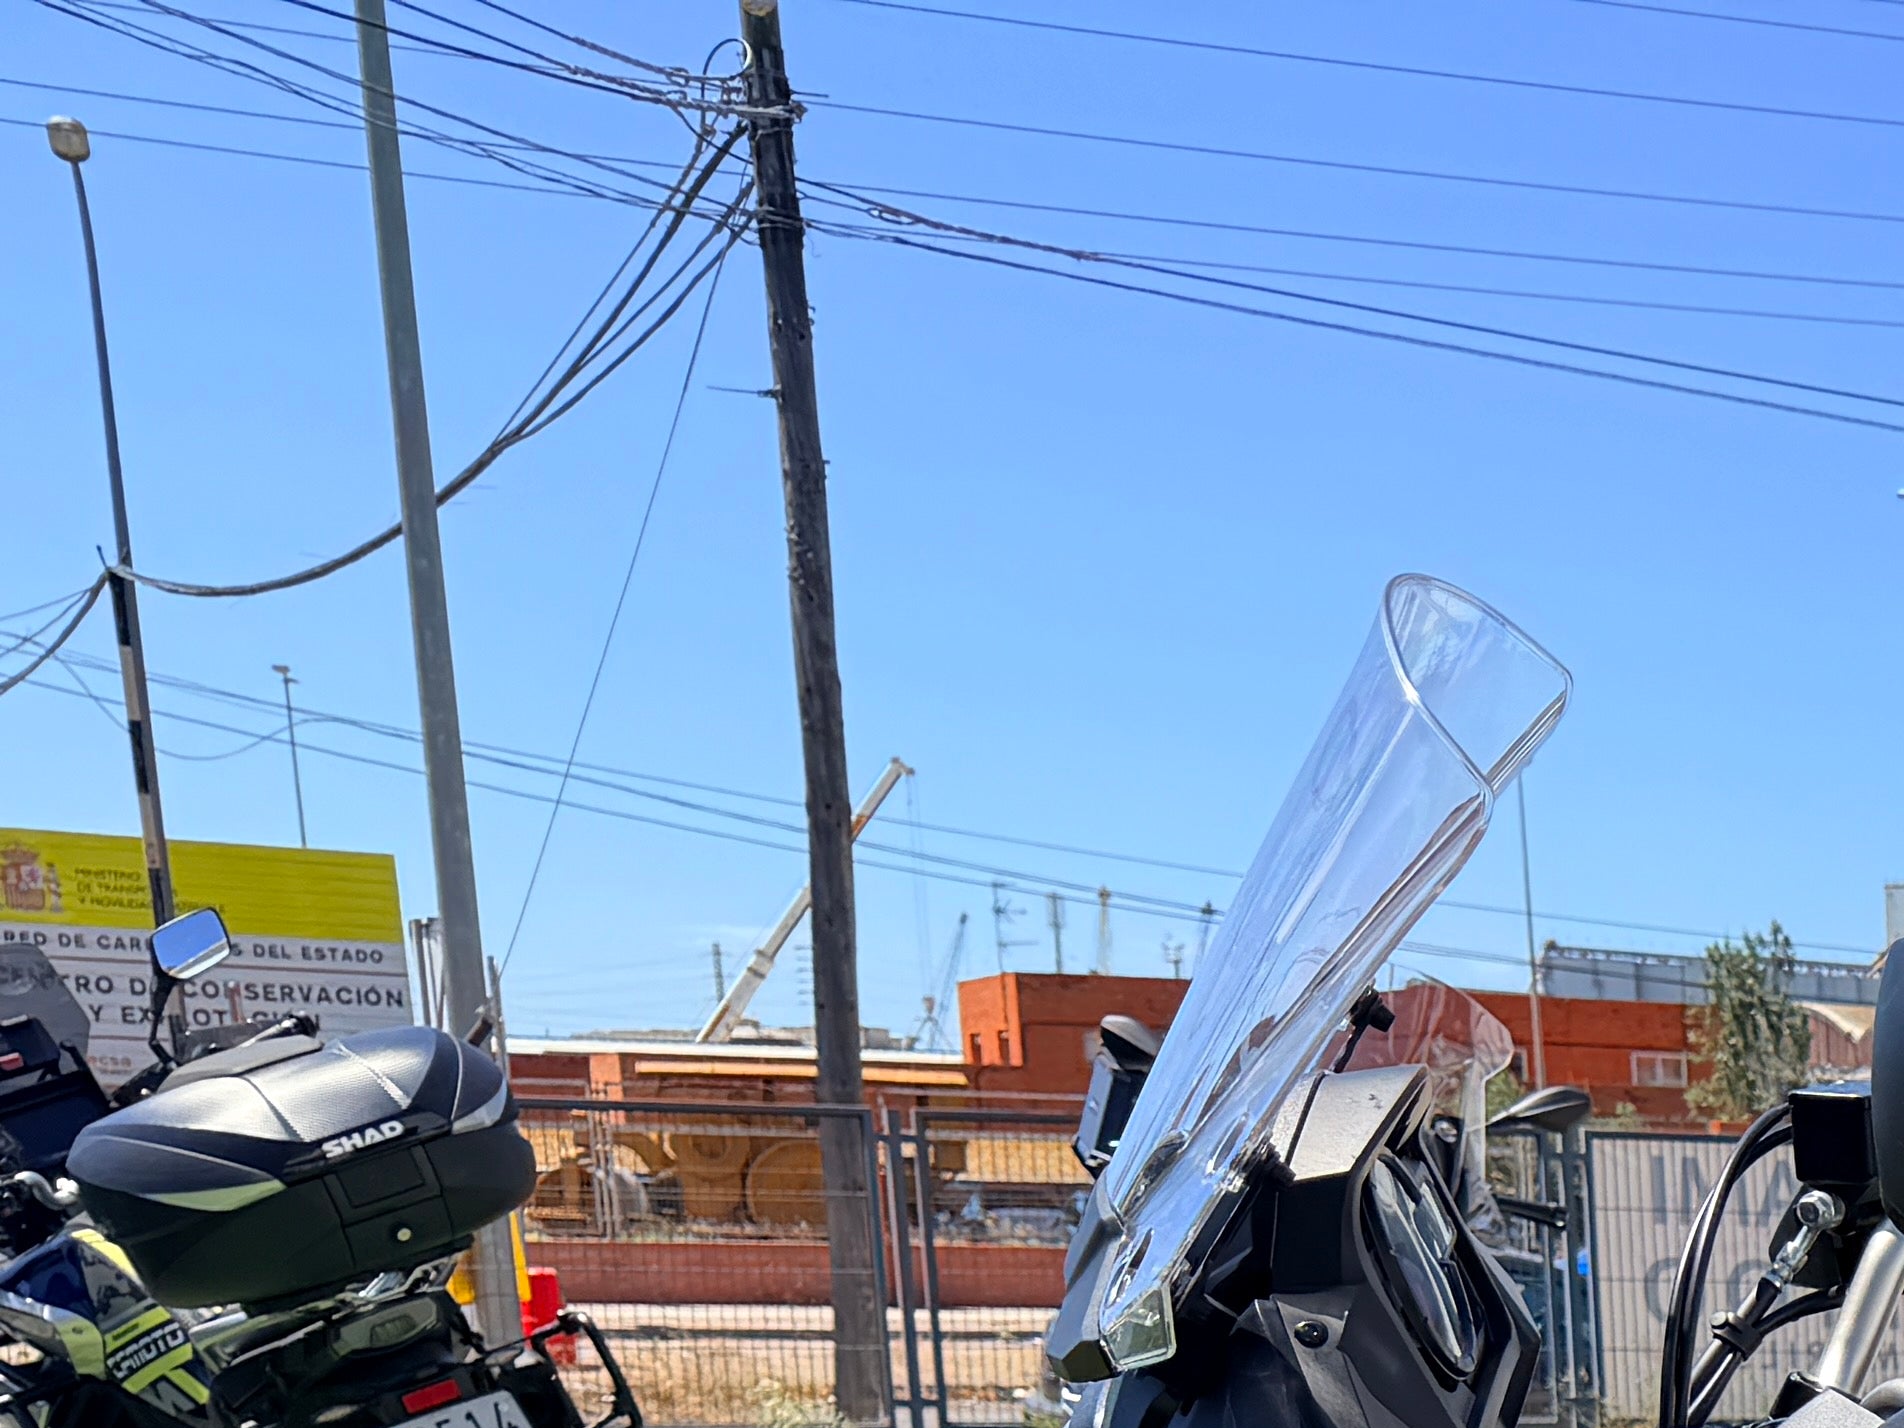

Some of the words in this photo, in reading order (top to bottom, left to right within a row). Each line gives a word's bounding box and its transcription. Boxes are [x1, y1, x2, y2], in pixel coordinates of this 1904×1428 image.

[58, 933, 86, 948] DE
[253, 944, 292, 960] DEL
[302, 945, 384, 964] ESTADO
[89, 1004, 102, 1023] Y
[321, 1120, 405, 1159] SHAD
